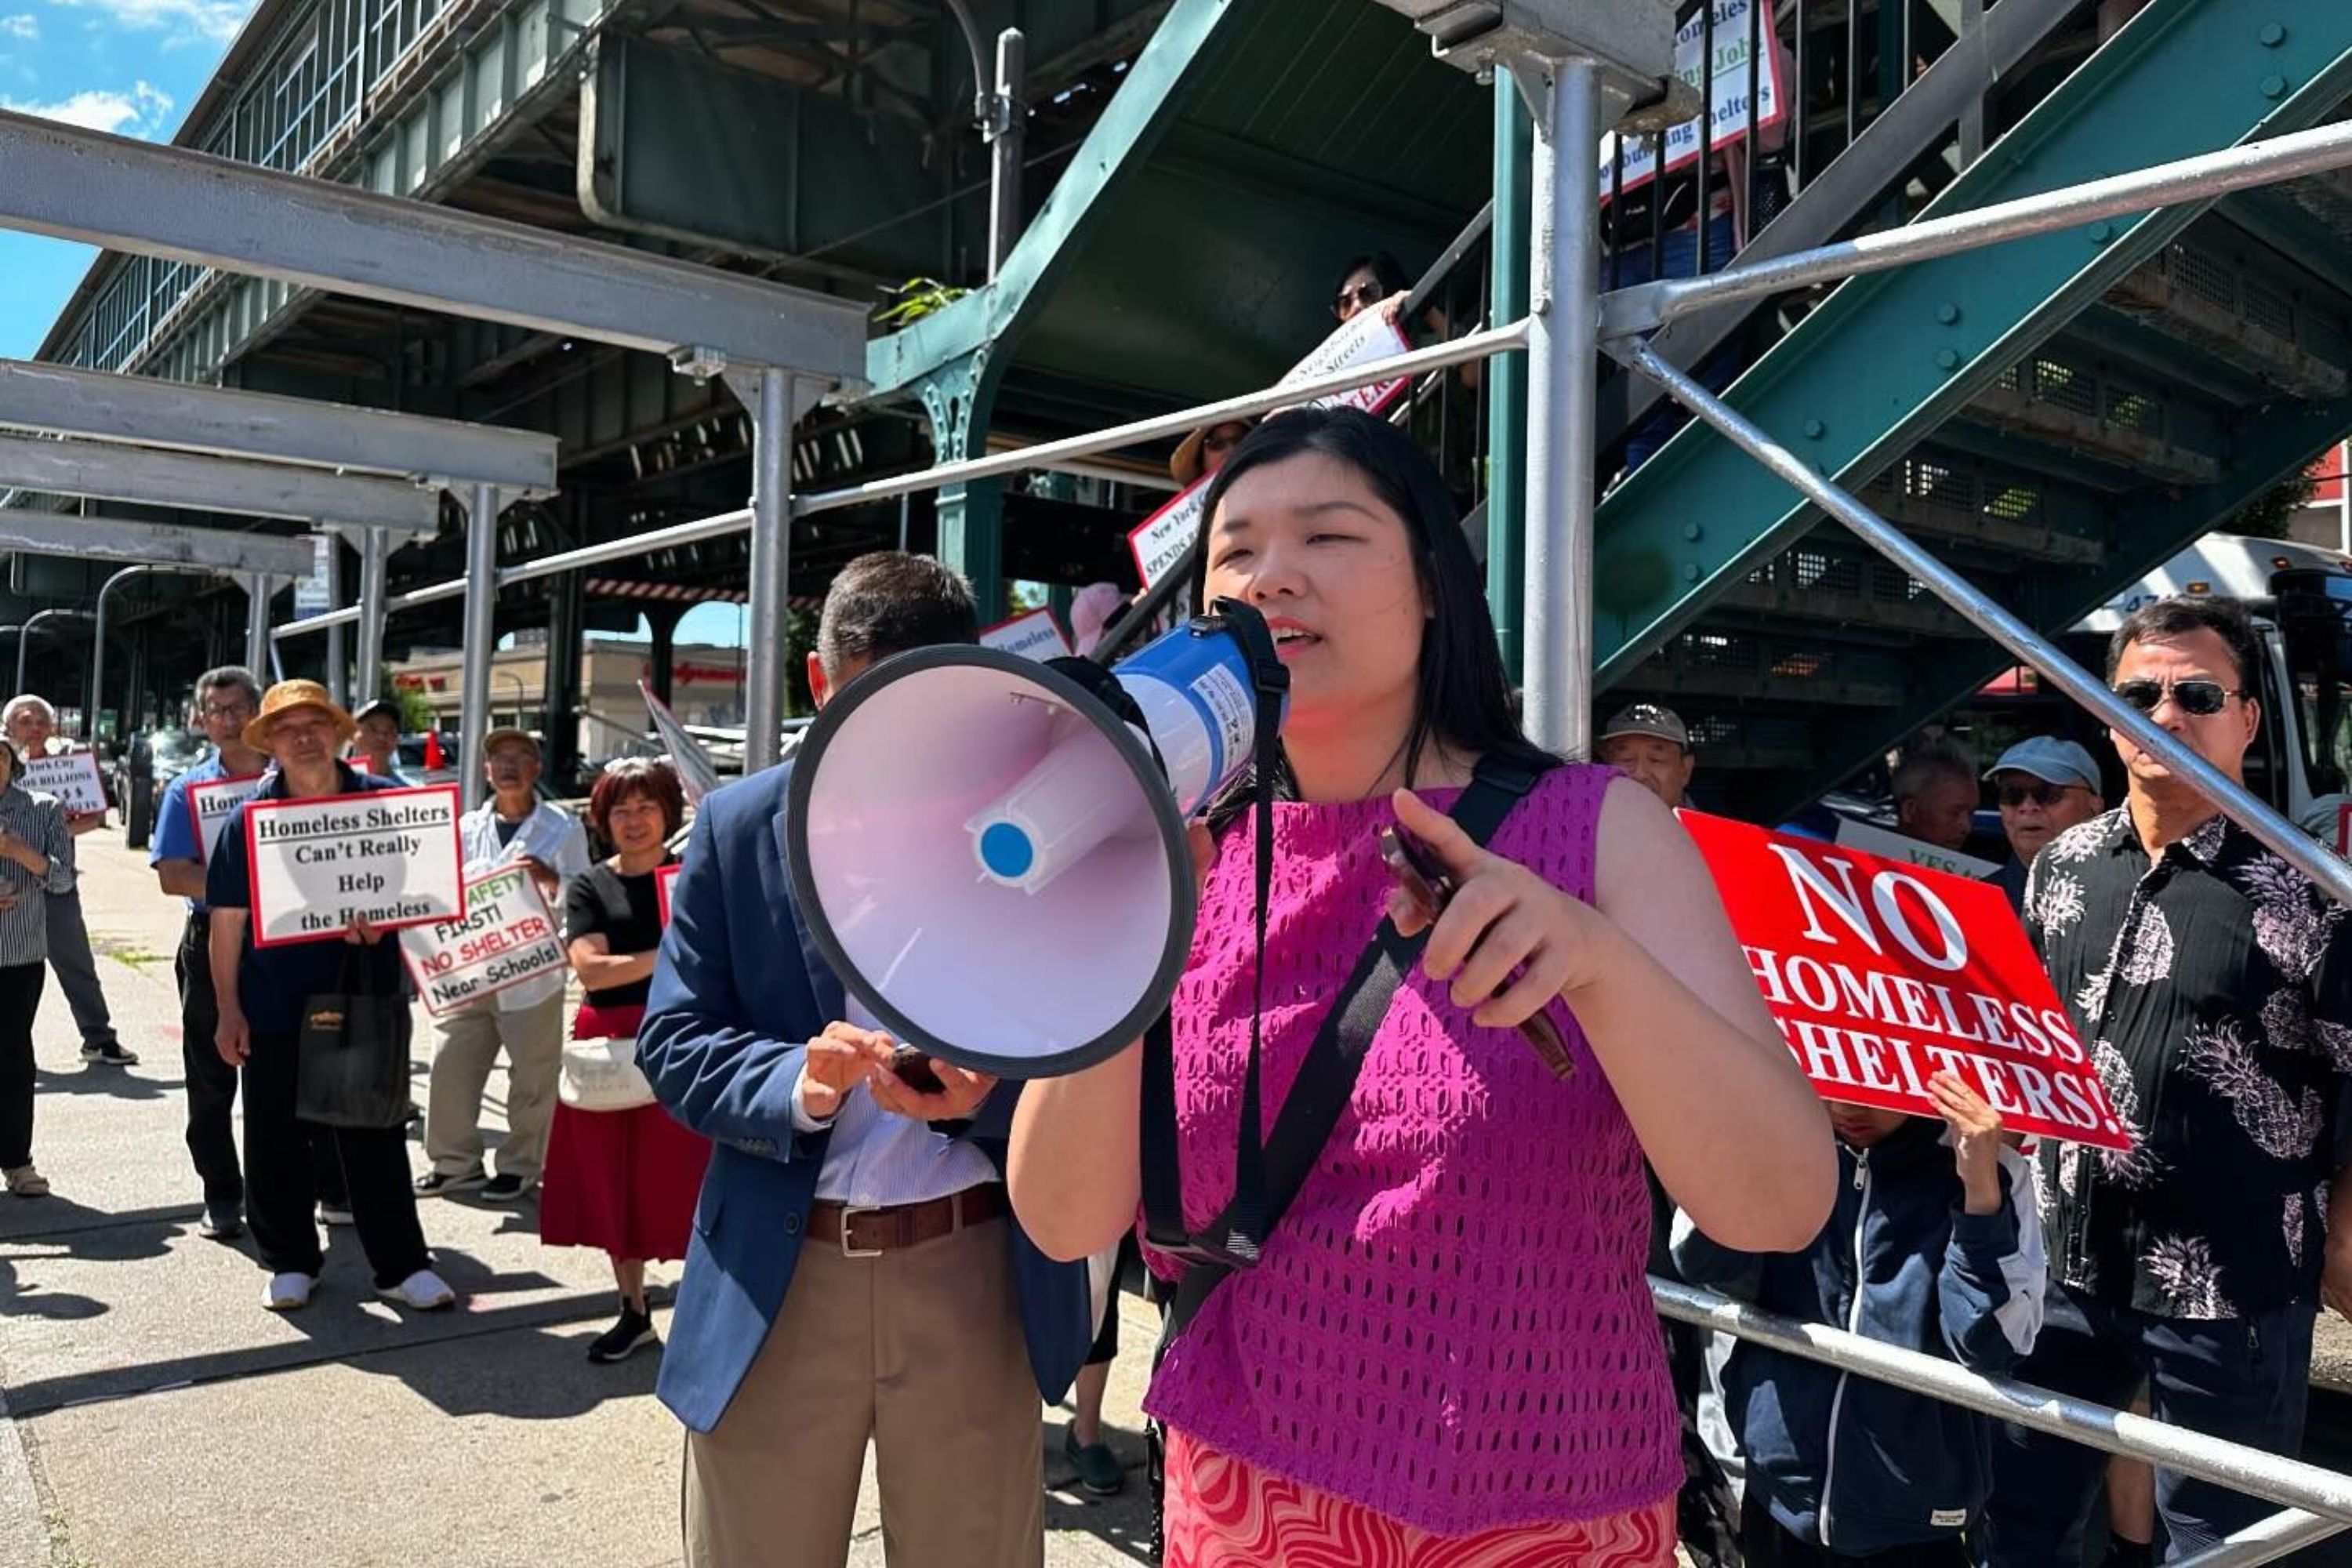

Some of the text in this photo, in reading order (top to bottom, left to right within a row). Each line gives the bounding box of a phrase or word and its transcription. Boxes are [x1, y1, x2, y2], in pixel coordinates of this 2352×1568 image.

[1150, 521, 1172, 540] New
[259, 805, 450, 838] Homeless Shelters
[296, 835, 421, 864] Can't Really
[337, 872, 385, 893] Help
[467, 870, 525, 907] AFETY
[301, 912, 332, 931] the
[1767, 842, 1968, 971] NO
[420, 916, 547, 977] NO SHELTER
[432, 942, 561, 1004] Near Schools!
[1741, 946, 2085, 1064] HOMELESS
